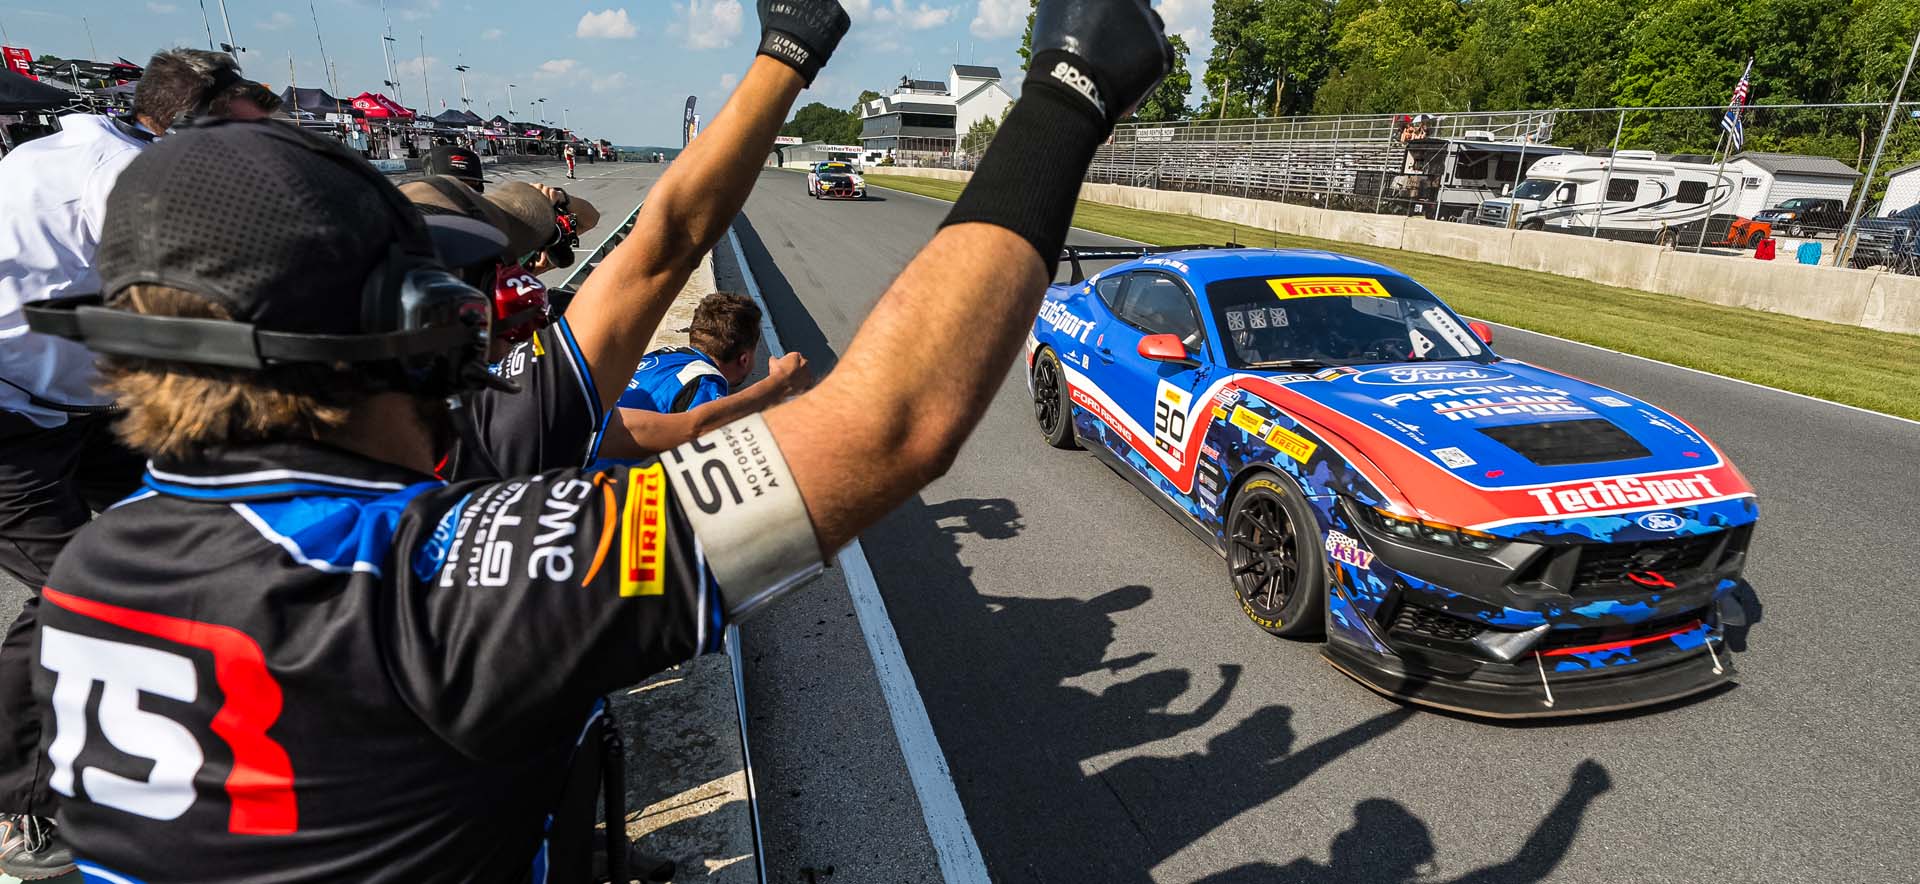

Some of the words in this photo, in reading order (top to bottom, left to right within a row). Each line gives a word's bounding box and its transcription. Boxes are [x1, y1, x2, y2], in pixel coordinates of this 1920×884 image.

[773, 35, 809, 59] GAMBIT
[1282, 280, 1379, 297] PIRELLI
[1037, 295, 1097, 344] echSport
[1388, 365, 1489, 383] Ford
[1073, 389, 1101, 417] FORD
[1100, 407, 1133, 442] RACING
[1379, 385, 1571, 408] RACING
[1431, 396, 1591, 421] INLINE
[1155, 399, 1186, 443] 30
[740, 425, 780, 489] AMERICA
[1271, 430, 1310, 458] PIRELLI
[1528, 473, 1724, 515] TechSport
[466, 482, 523, 587] MUSTANG
[527, 478, 592, 582] aws
[629, 471, 659, 582] PIRELLI
